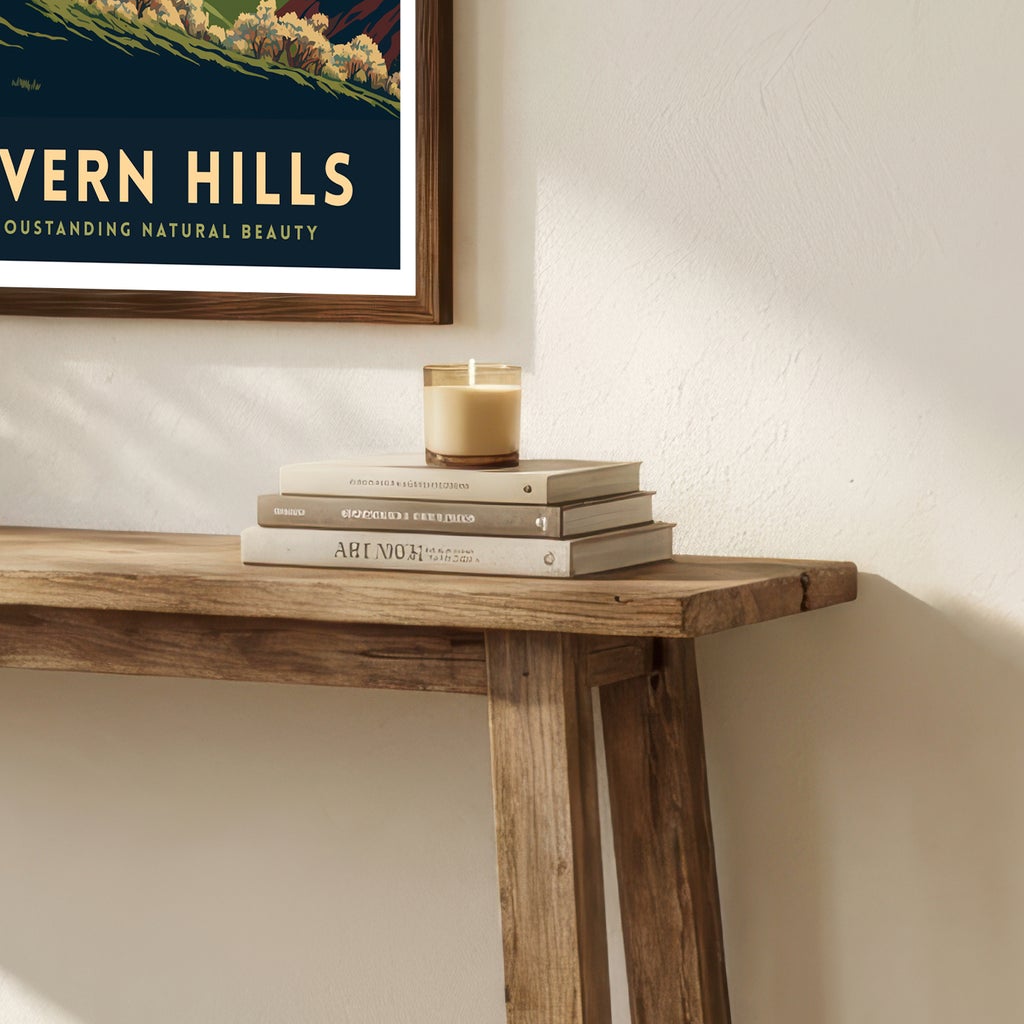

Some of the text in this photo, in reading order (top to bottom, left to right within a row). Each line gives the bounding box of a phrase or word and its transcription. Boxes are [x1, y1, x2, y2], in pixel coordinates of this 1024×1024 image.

[187, 150, 354, 207] HILLS
[3, 219, 131, 237] OUSTANDING
[142, 221, 231, 239] NATURAL
[241, 223, 318, 241] BEAUTY
